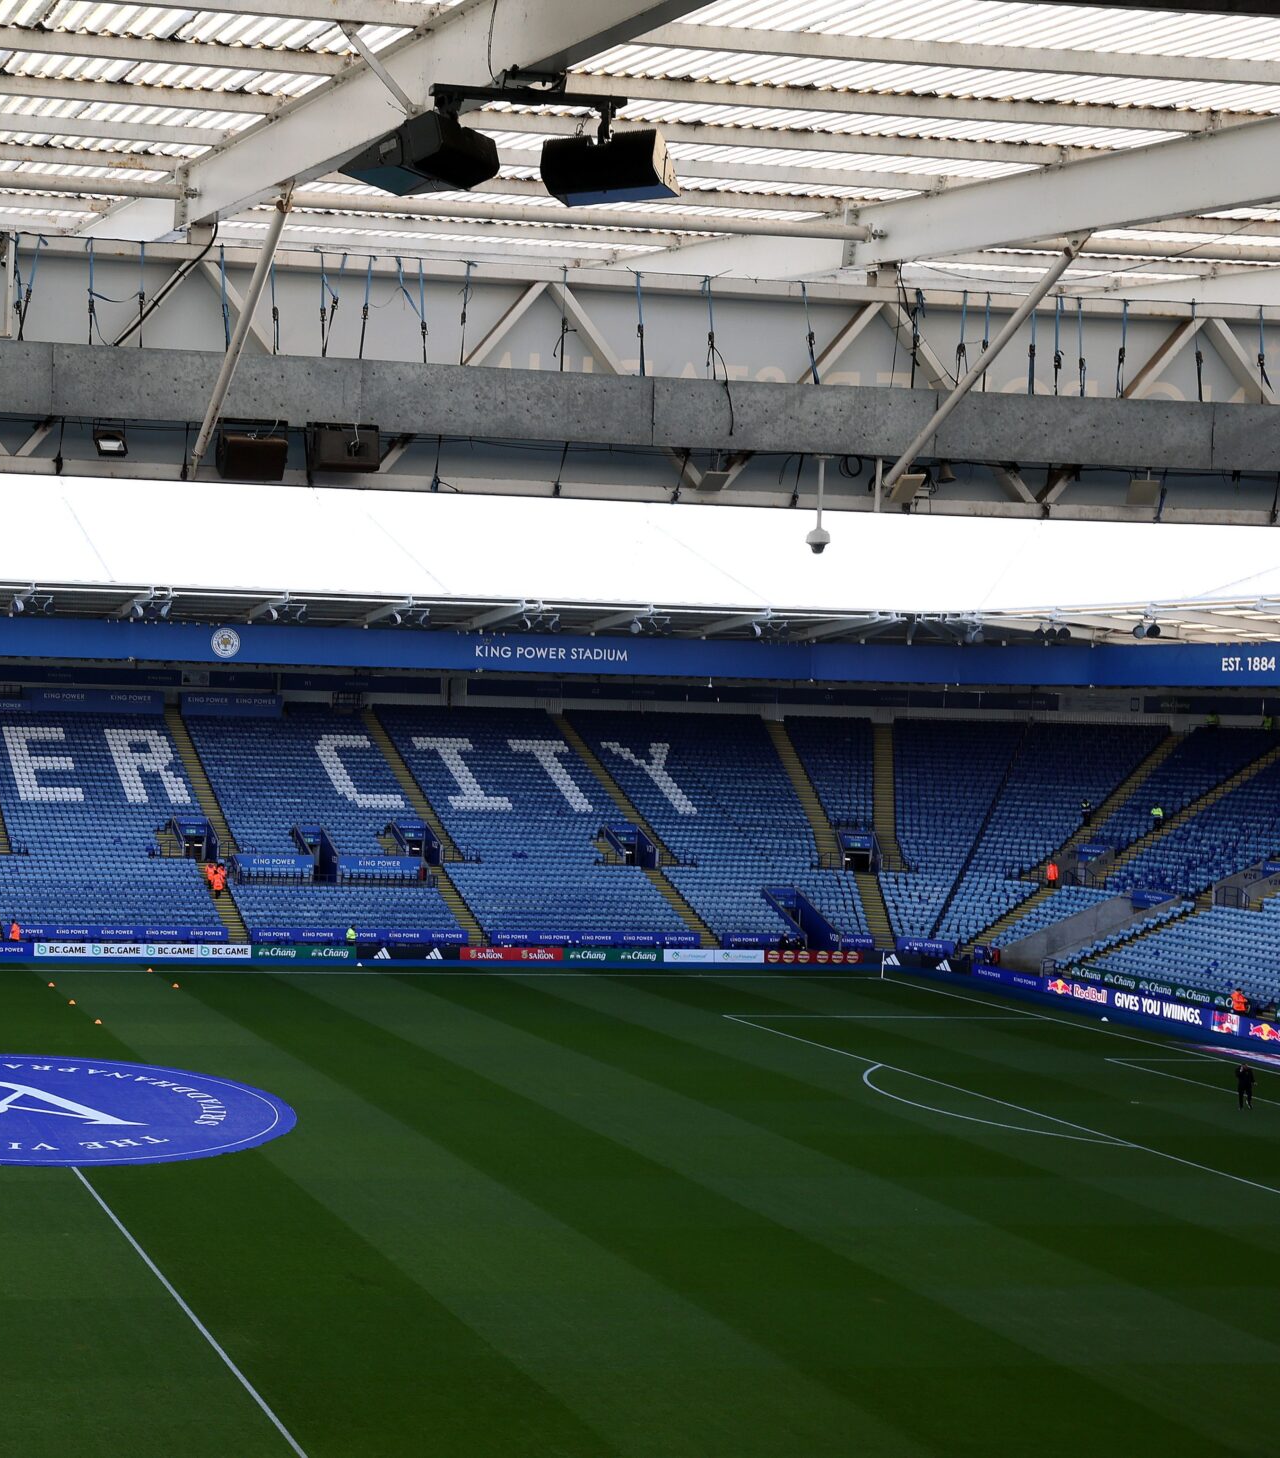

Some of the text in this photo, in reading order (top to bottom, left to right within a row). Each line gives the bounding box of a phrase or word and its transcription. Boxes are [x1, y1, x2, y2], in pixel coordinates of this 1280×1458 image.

[476, 646, 628, 661] KING POWER STADIUM
[1222, 657, 1275, 671] EST. 1884
[315, 734, 697, 815] CITY
[48, 945, 86, 954] BC.GAME
[104, 946, 140, 955] BC.GAME
[158, 946, 194, 955] BC.GAME
[212, 947, 248, 955] BC.GAME
[270, 948, 296, 957] Chang
[323, 948, 348, 958] Chang
[581, 951, 606, 960] Chang
[632, 951, 656, 961] Chang
[1115, 992, 1202, 1025] GIVES YOU WIIINGS.
[78, 1134, 170, 1150] THE
